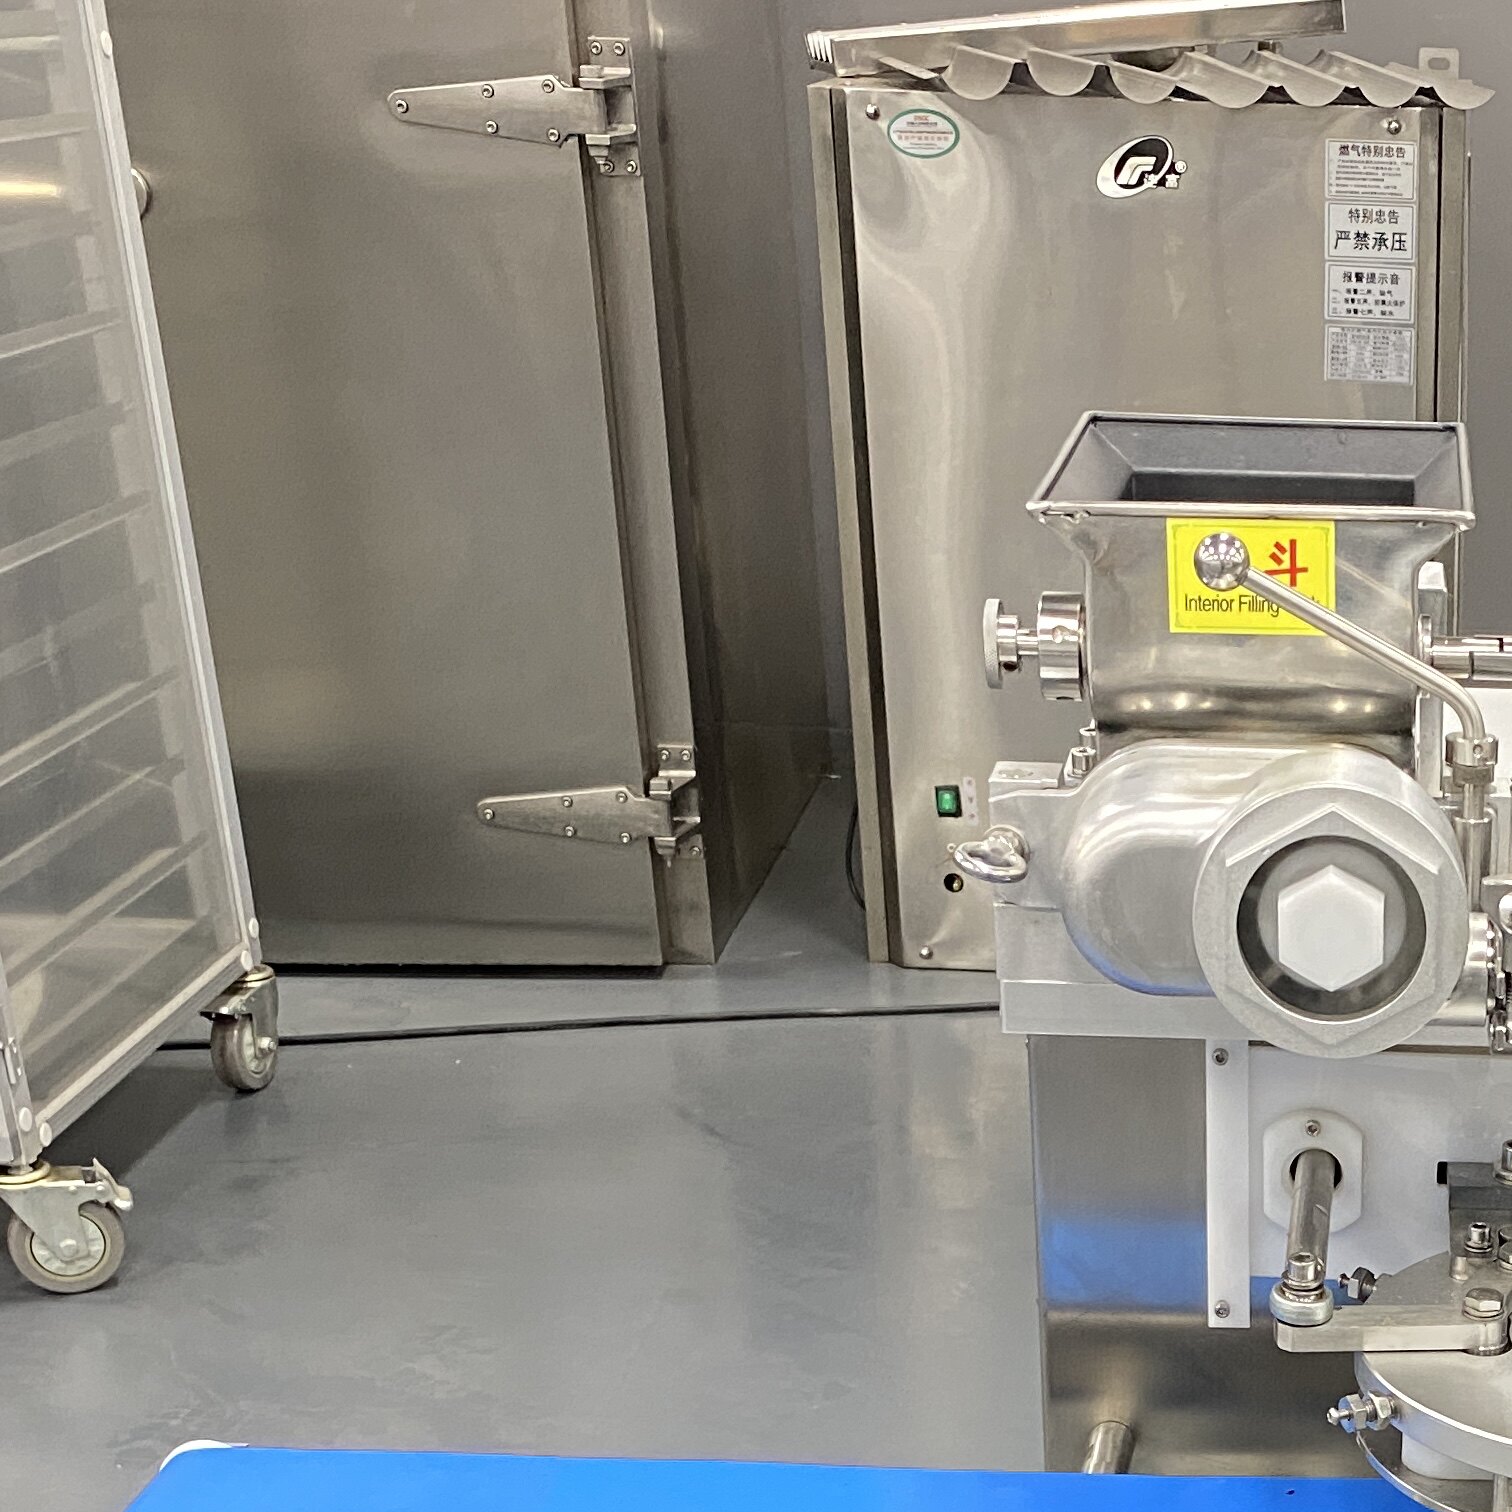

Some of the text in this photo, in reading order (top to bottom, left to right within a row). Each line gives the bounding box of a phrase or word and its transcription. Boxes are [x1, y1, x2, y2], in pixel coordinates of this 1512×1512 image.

[1338, 144, 1406, 158] 燃气特别忠告
[1348, 208, 1400, 224] 特别忠告
[1334, 229, 1408, 252] 严禁承压
[1342, 271, 1400, 285] 报警提示音
[1184, 594, 1280, 617] Interior Filling
